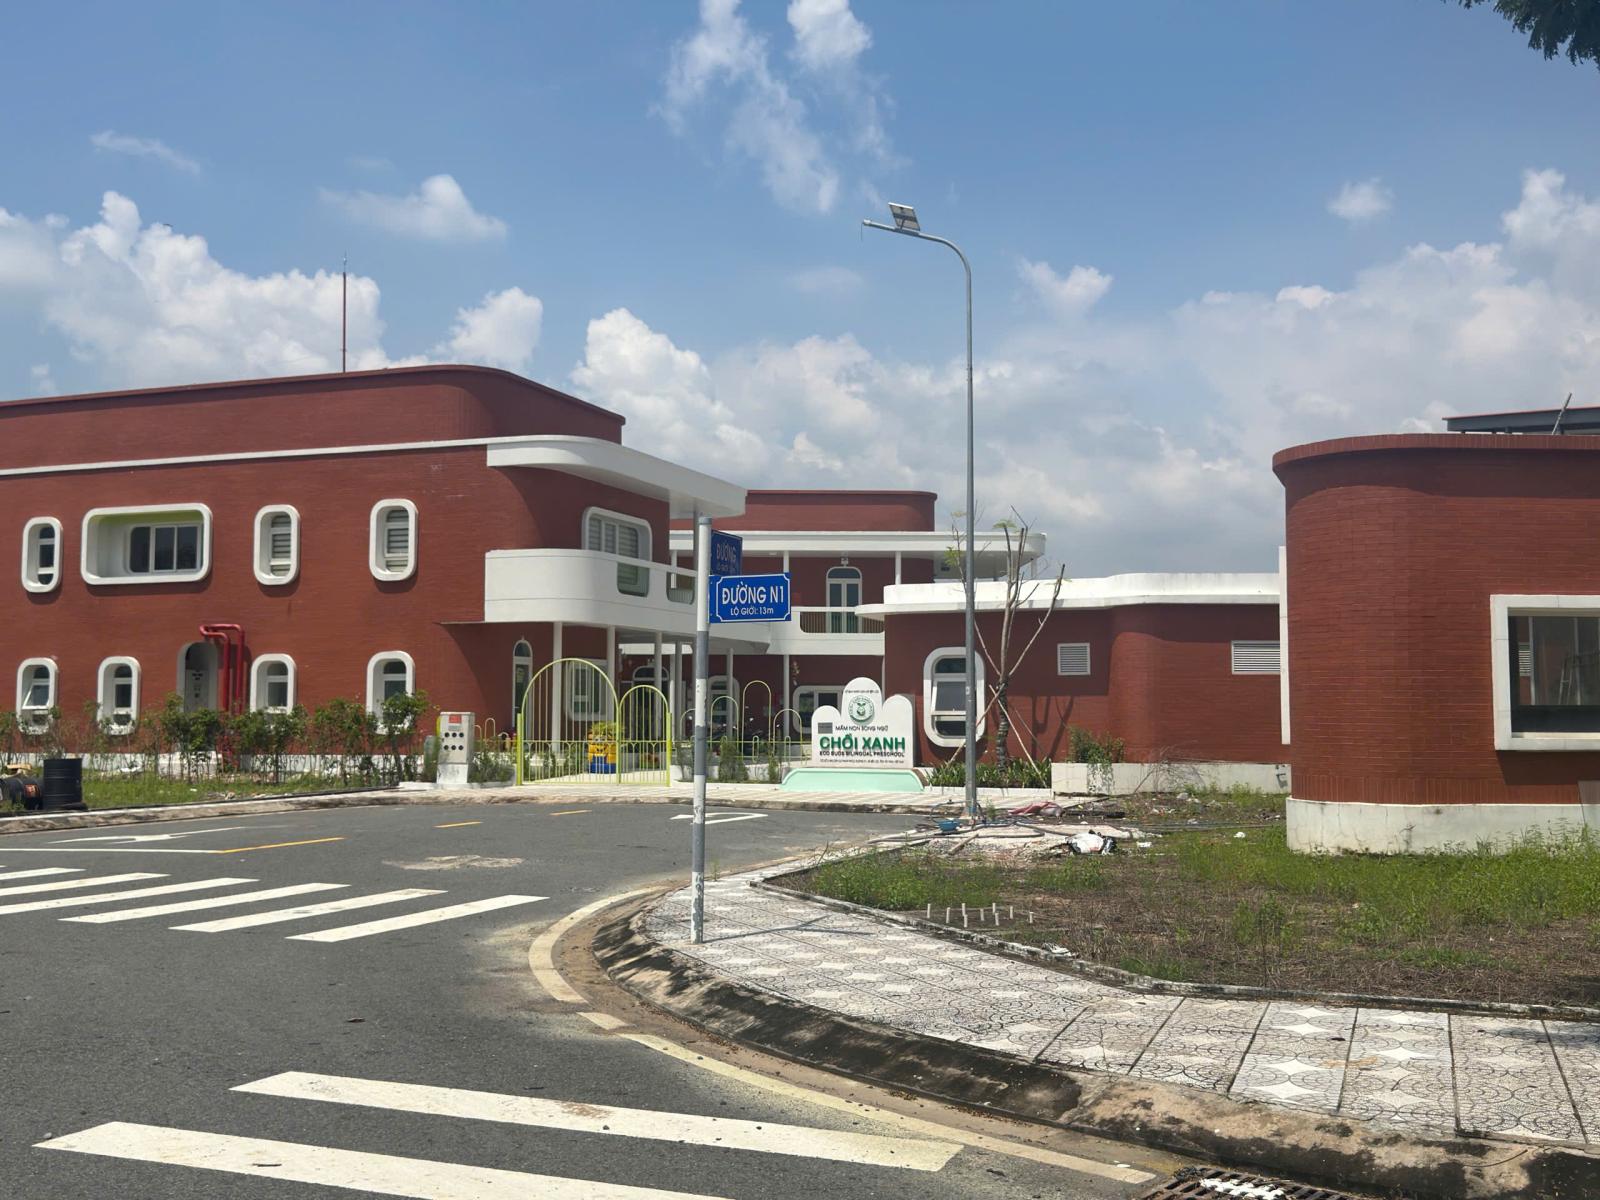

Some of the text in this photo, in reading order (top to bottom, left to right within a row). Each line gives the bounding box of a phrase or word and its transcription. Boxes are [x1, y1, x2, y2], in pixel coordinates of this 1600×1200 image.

[722, 581, 784, 605] ĐƯỜNG N1
[730, 606, 740, 617] LỘ
[759, 606, 774, 616] 13m
[862, 737, 906, 750] XANH
